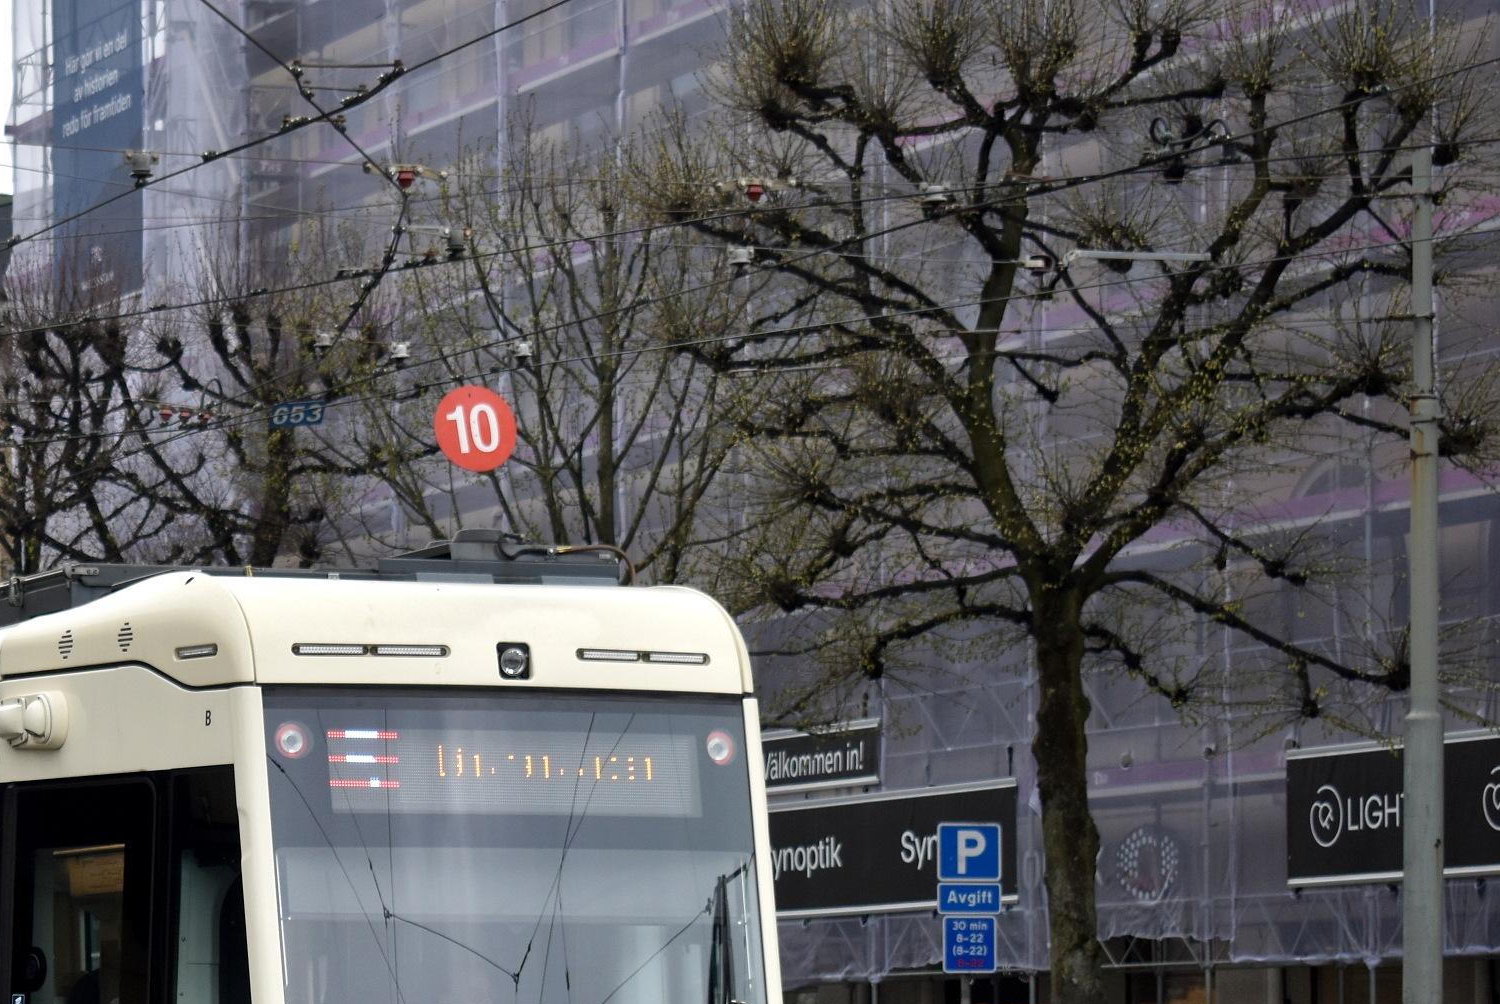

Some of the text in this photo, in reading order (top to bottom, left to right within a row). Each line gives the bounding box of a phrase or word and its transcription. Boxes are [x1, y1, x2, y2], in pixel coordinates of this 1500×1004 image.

[79, 47, 94, 74] gör
[103, 40, 114, 59] en
[115, 28, 128, 53] del
[73, 68, 119, 103] av historien
[80, 108, 93, 130] för
[93, 93, 132, 124] framtiden
[272, 404, 324, 426] 653
[446, 403, 499, 454] 10
[205, 710, 212, 726] B
[765, 740, 866, 781] Välkommen in!
[771, 835, 843, 880] ynoptik
[956, 829, 987, 875] P
[947, 889, 993, 907] Avgift
[952, 920, 988, 931] 30 min
[956, 933, 984, 944] 8-22
[952, 945, 987, 956] (8-22)
